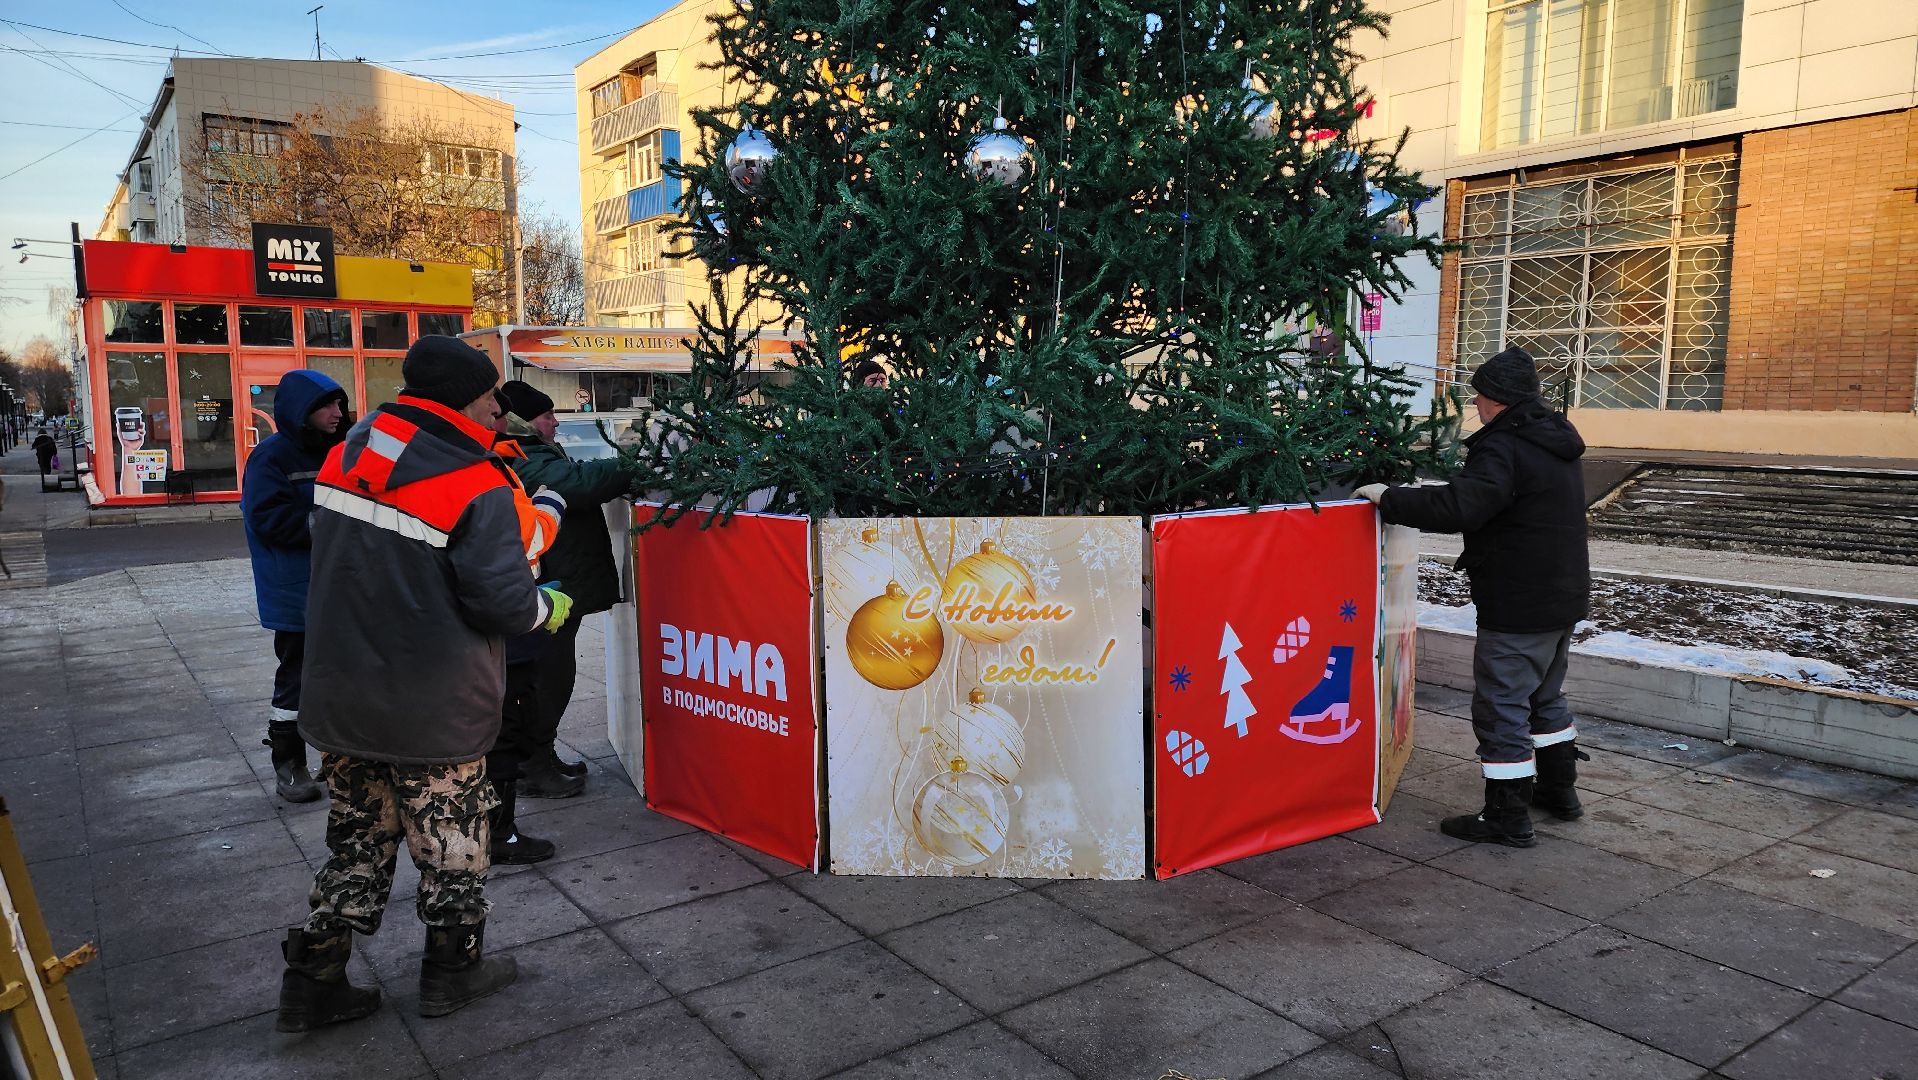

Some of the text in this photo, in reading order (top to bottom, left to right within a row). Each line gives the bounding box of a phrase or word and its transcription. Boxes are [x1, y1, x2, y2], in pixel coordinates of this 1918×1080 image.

[571, 336, 616, 348] ХЛЕБ
[904, 581, 1072, 624] С Новым
[660, 623, 788, 702] ЗИМА
[982, 638, 1116, 683] годом!
[662, 686, 789, 737] В ПОДМОСКОВЬЕ
